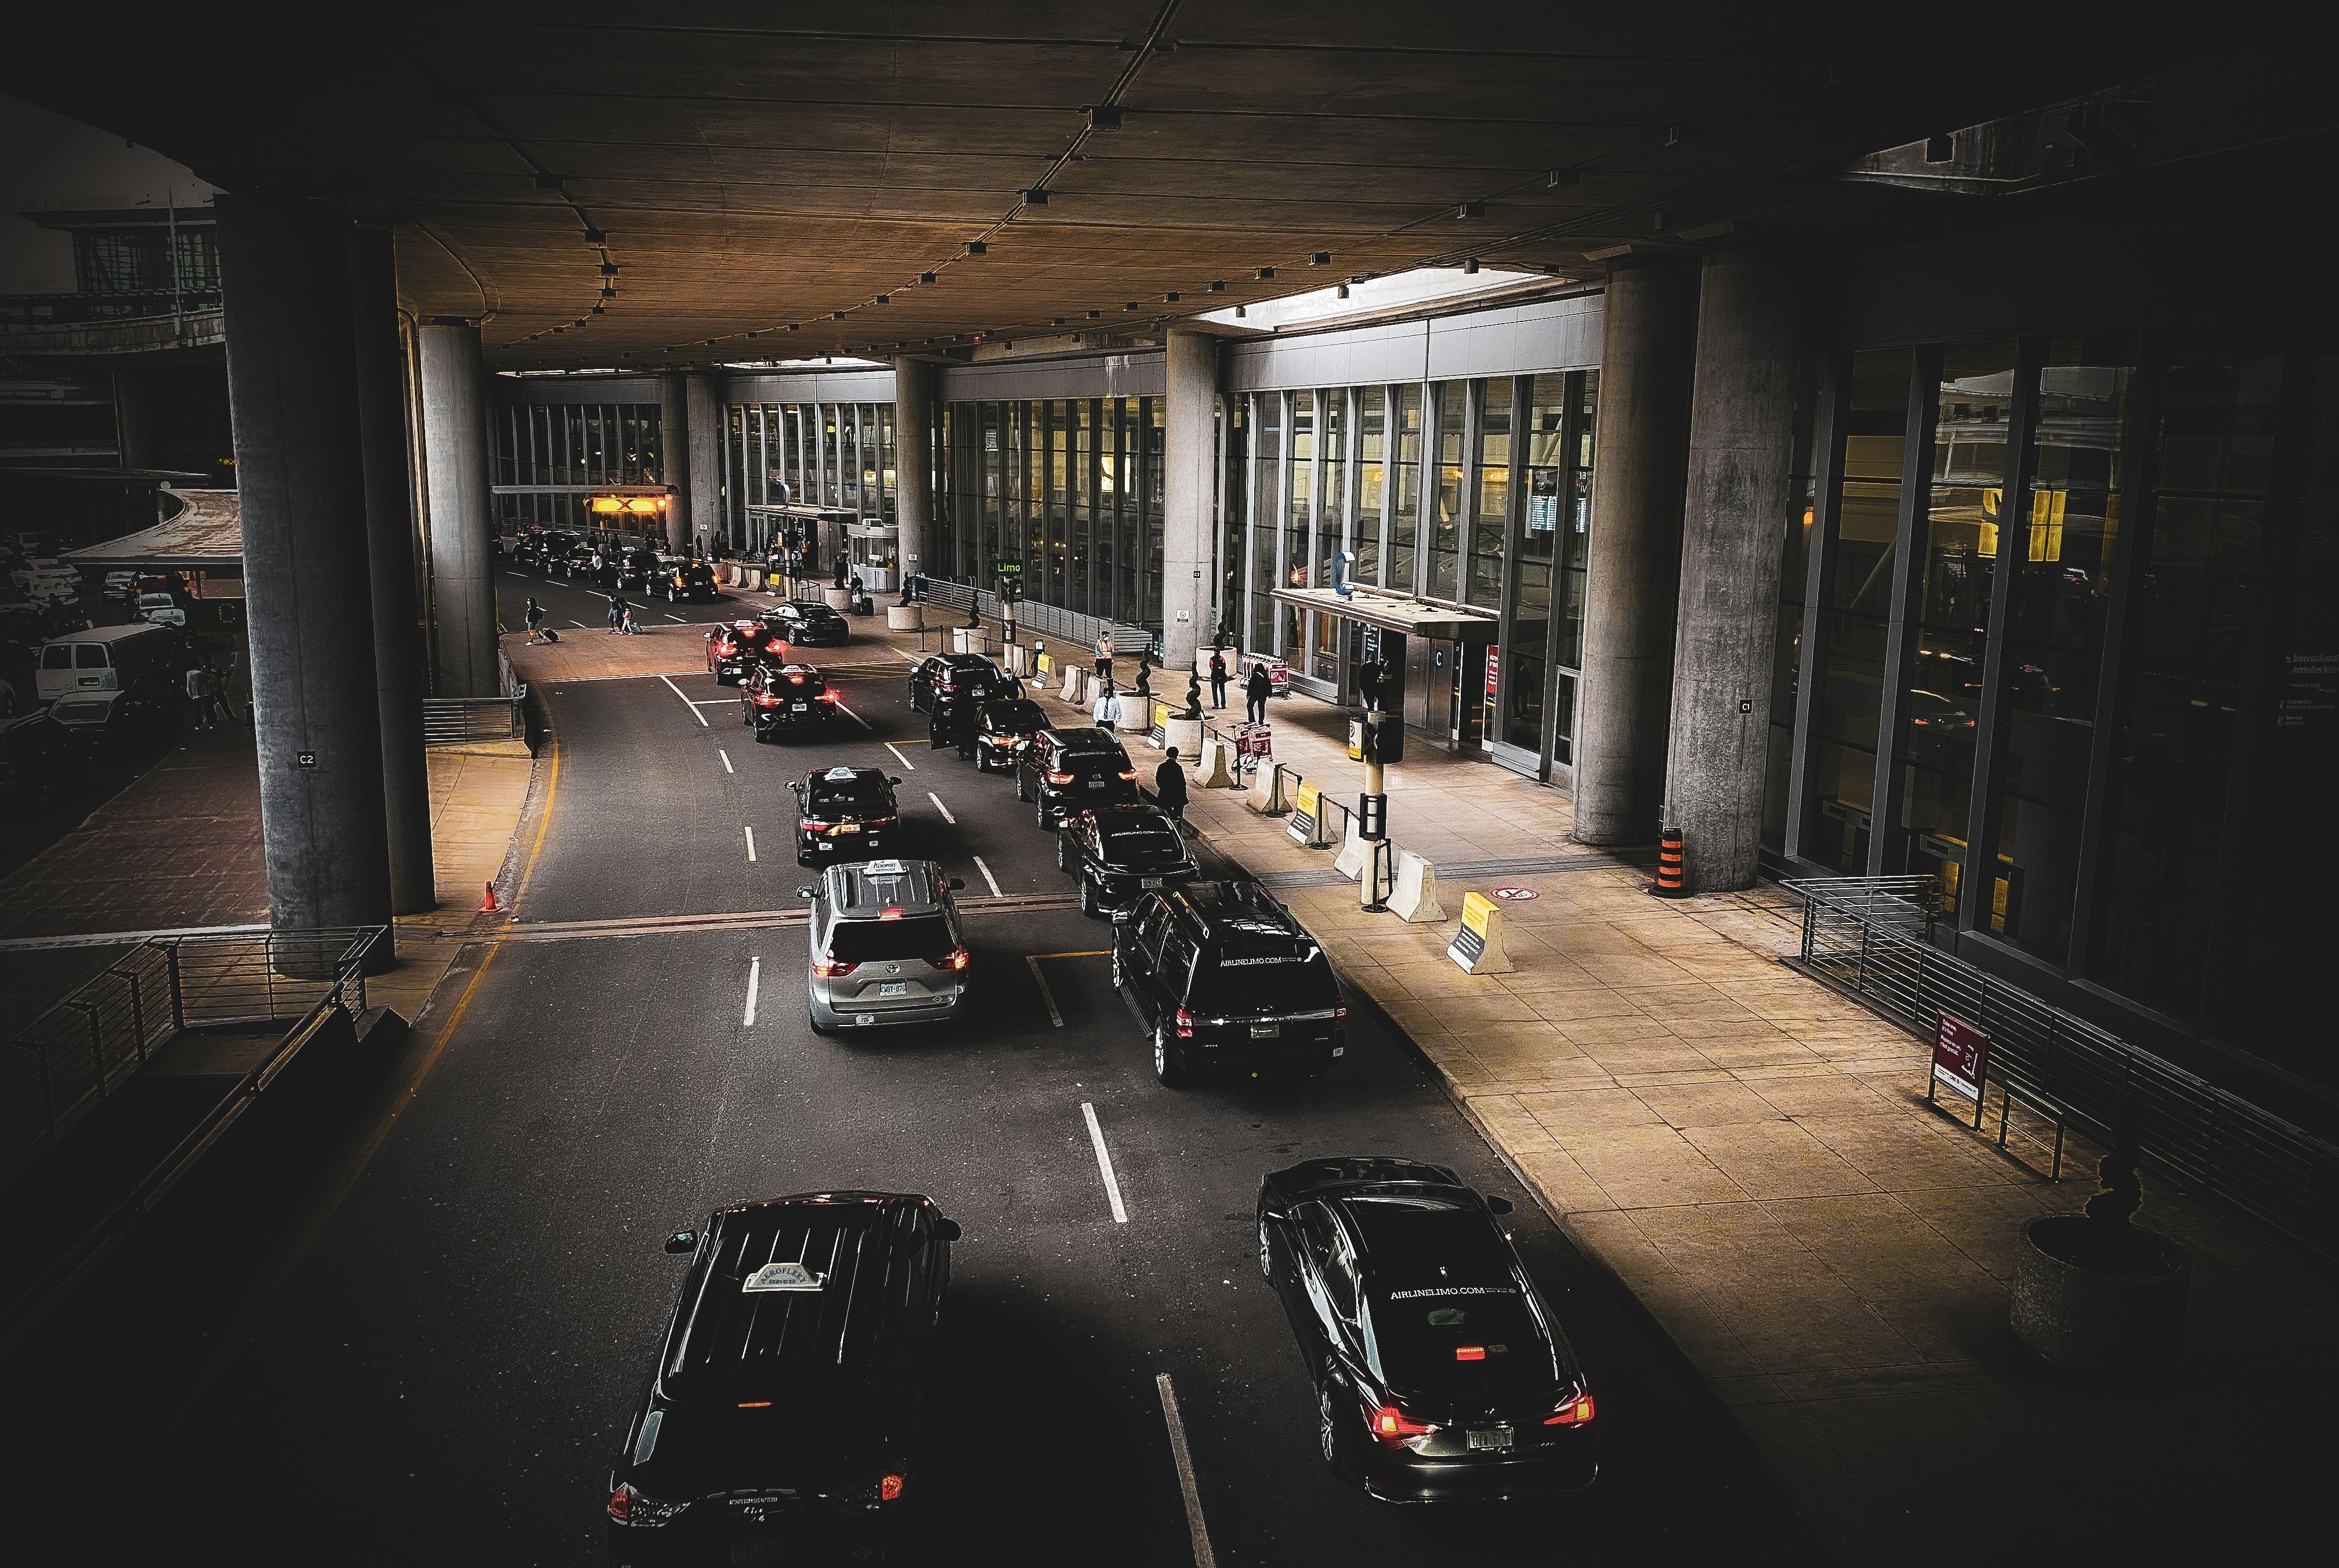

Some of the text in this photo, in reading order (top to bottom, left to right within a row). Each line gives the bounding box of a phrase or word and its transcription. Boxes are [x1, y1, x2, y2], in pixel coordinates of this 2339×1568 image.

[998, 563, 1020, 572] Limo
[1436, 651, 1442, 666] C
[1221, 957, 1281, 966] AIRLINELIMO.COM
[761, 1268, 806, 1284] AEROFLEET
[1391, 1287, 1485, 1299] AIRLINELIMO.COM
